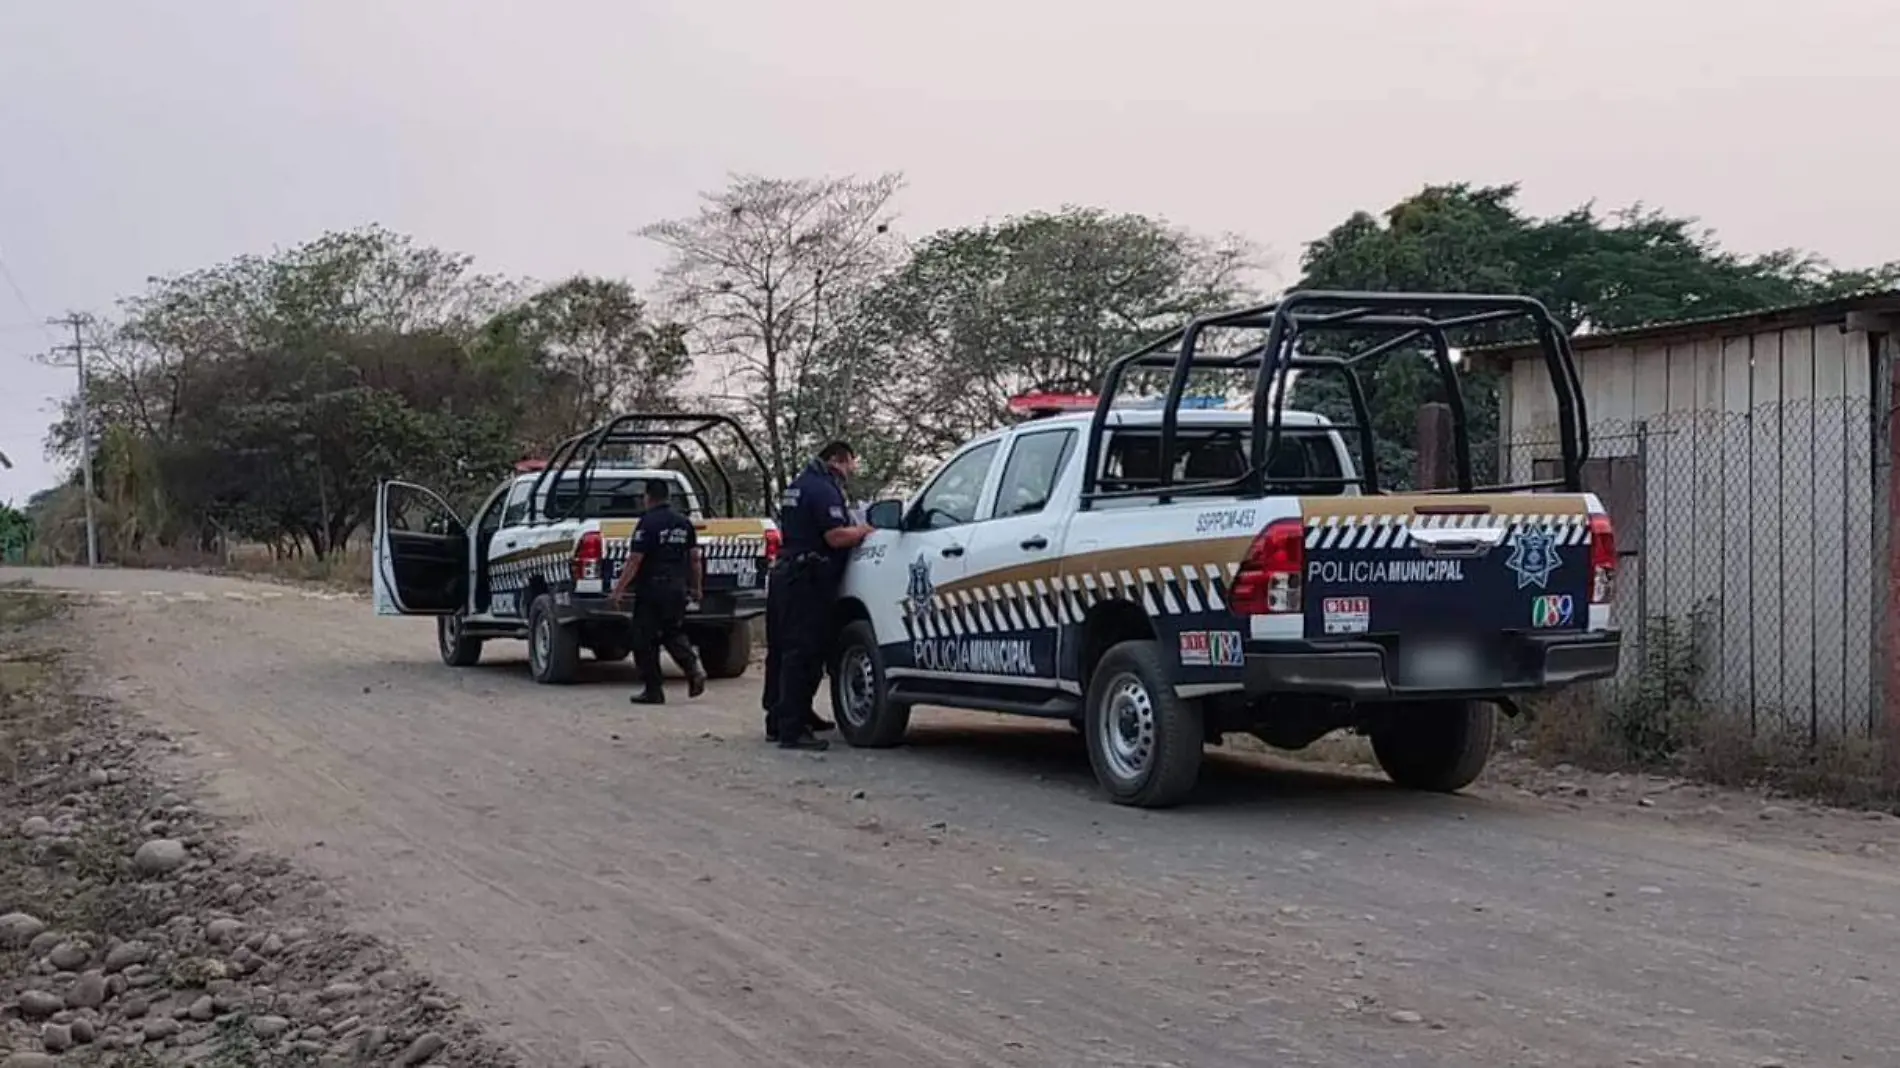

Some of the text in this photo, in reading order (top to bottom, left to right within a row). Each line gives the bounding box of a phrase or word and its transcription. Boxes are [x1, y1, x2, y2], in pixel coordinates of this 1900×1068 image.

[706, 558, 757, 575] MUNICIPAL
[1388, 559, 1464, 581] MUNICIPAL
[1532, 594, 1573, 628] 089
